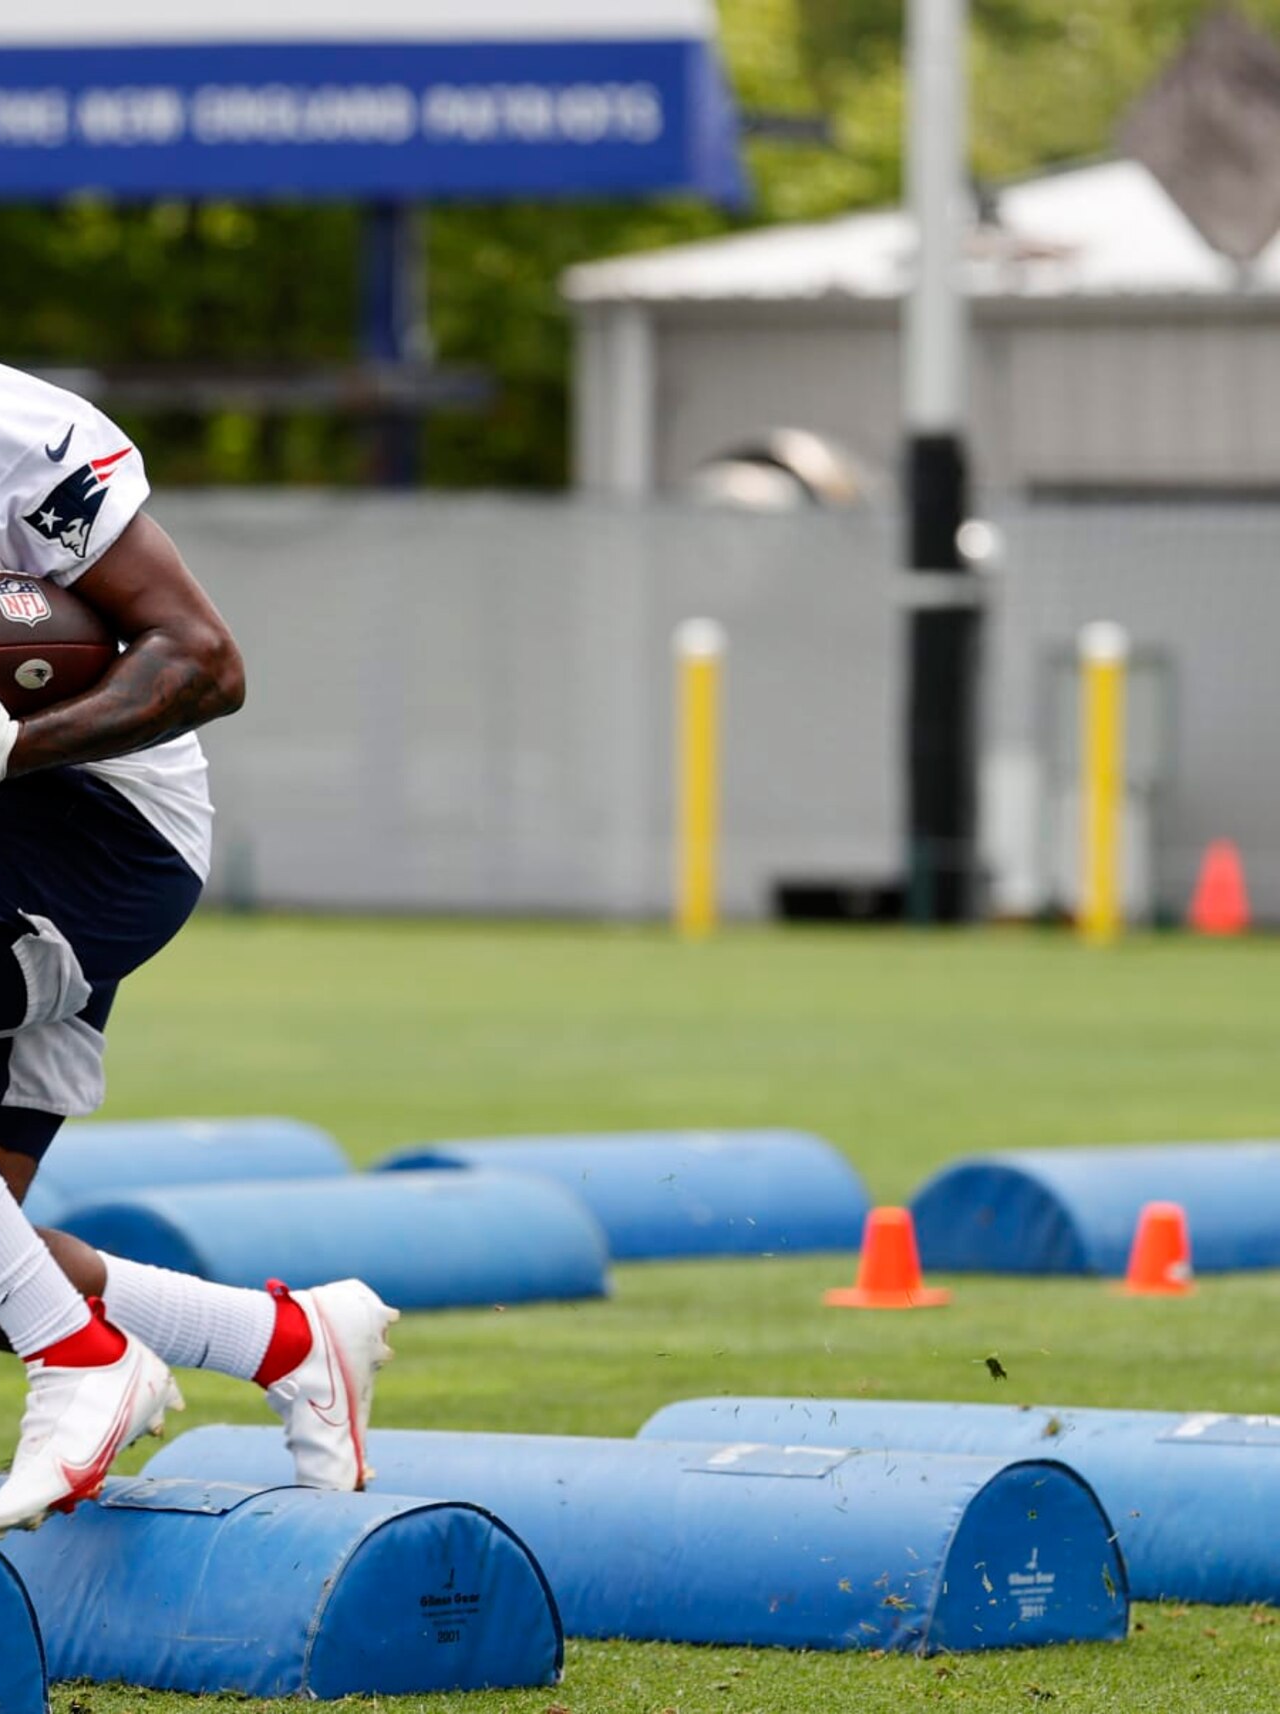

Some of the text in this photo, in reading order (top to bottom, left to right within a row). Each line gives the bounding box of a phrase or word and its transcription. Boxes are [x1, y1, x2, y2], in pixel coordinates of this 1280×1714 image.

[193, 85, 414, 144] ENGLAND
[425, 83, 660, 143] PATRIOTS
[3, 594, 45, 617] NFL
